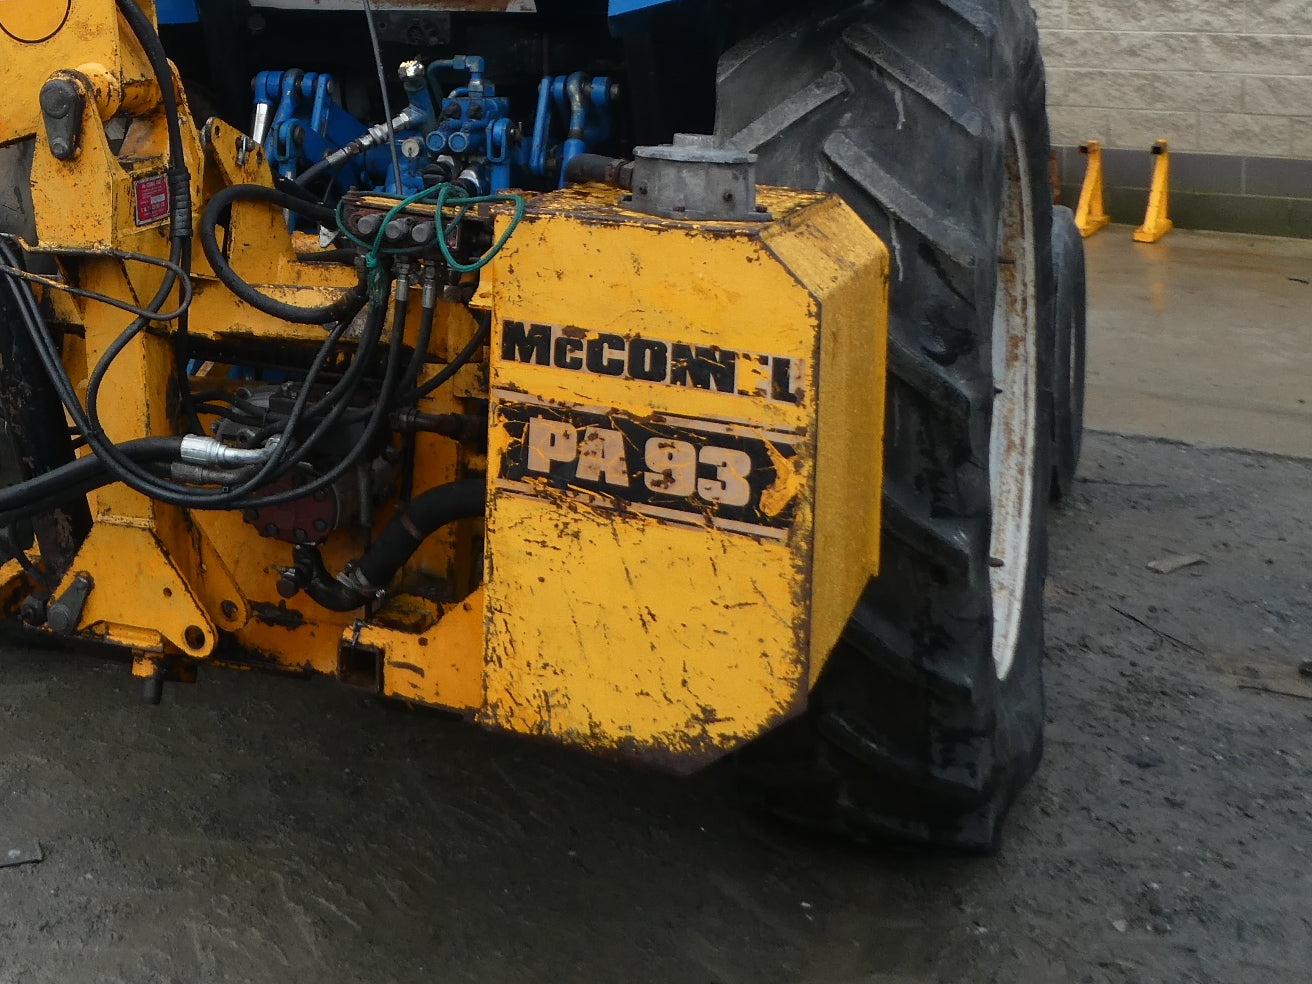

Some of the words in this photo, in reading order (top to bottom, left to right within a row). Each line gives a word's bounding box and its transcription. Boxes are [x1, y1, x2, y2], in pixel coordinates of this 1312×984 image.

[501, 320, 804, 403] McCONNL
[528, 417, 630, 487] PA
[644, 437, 752, 507] 93
